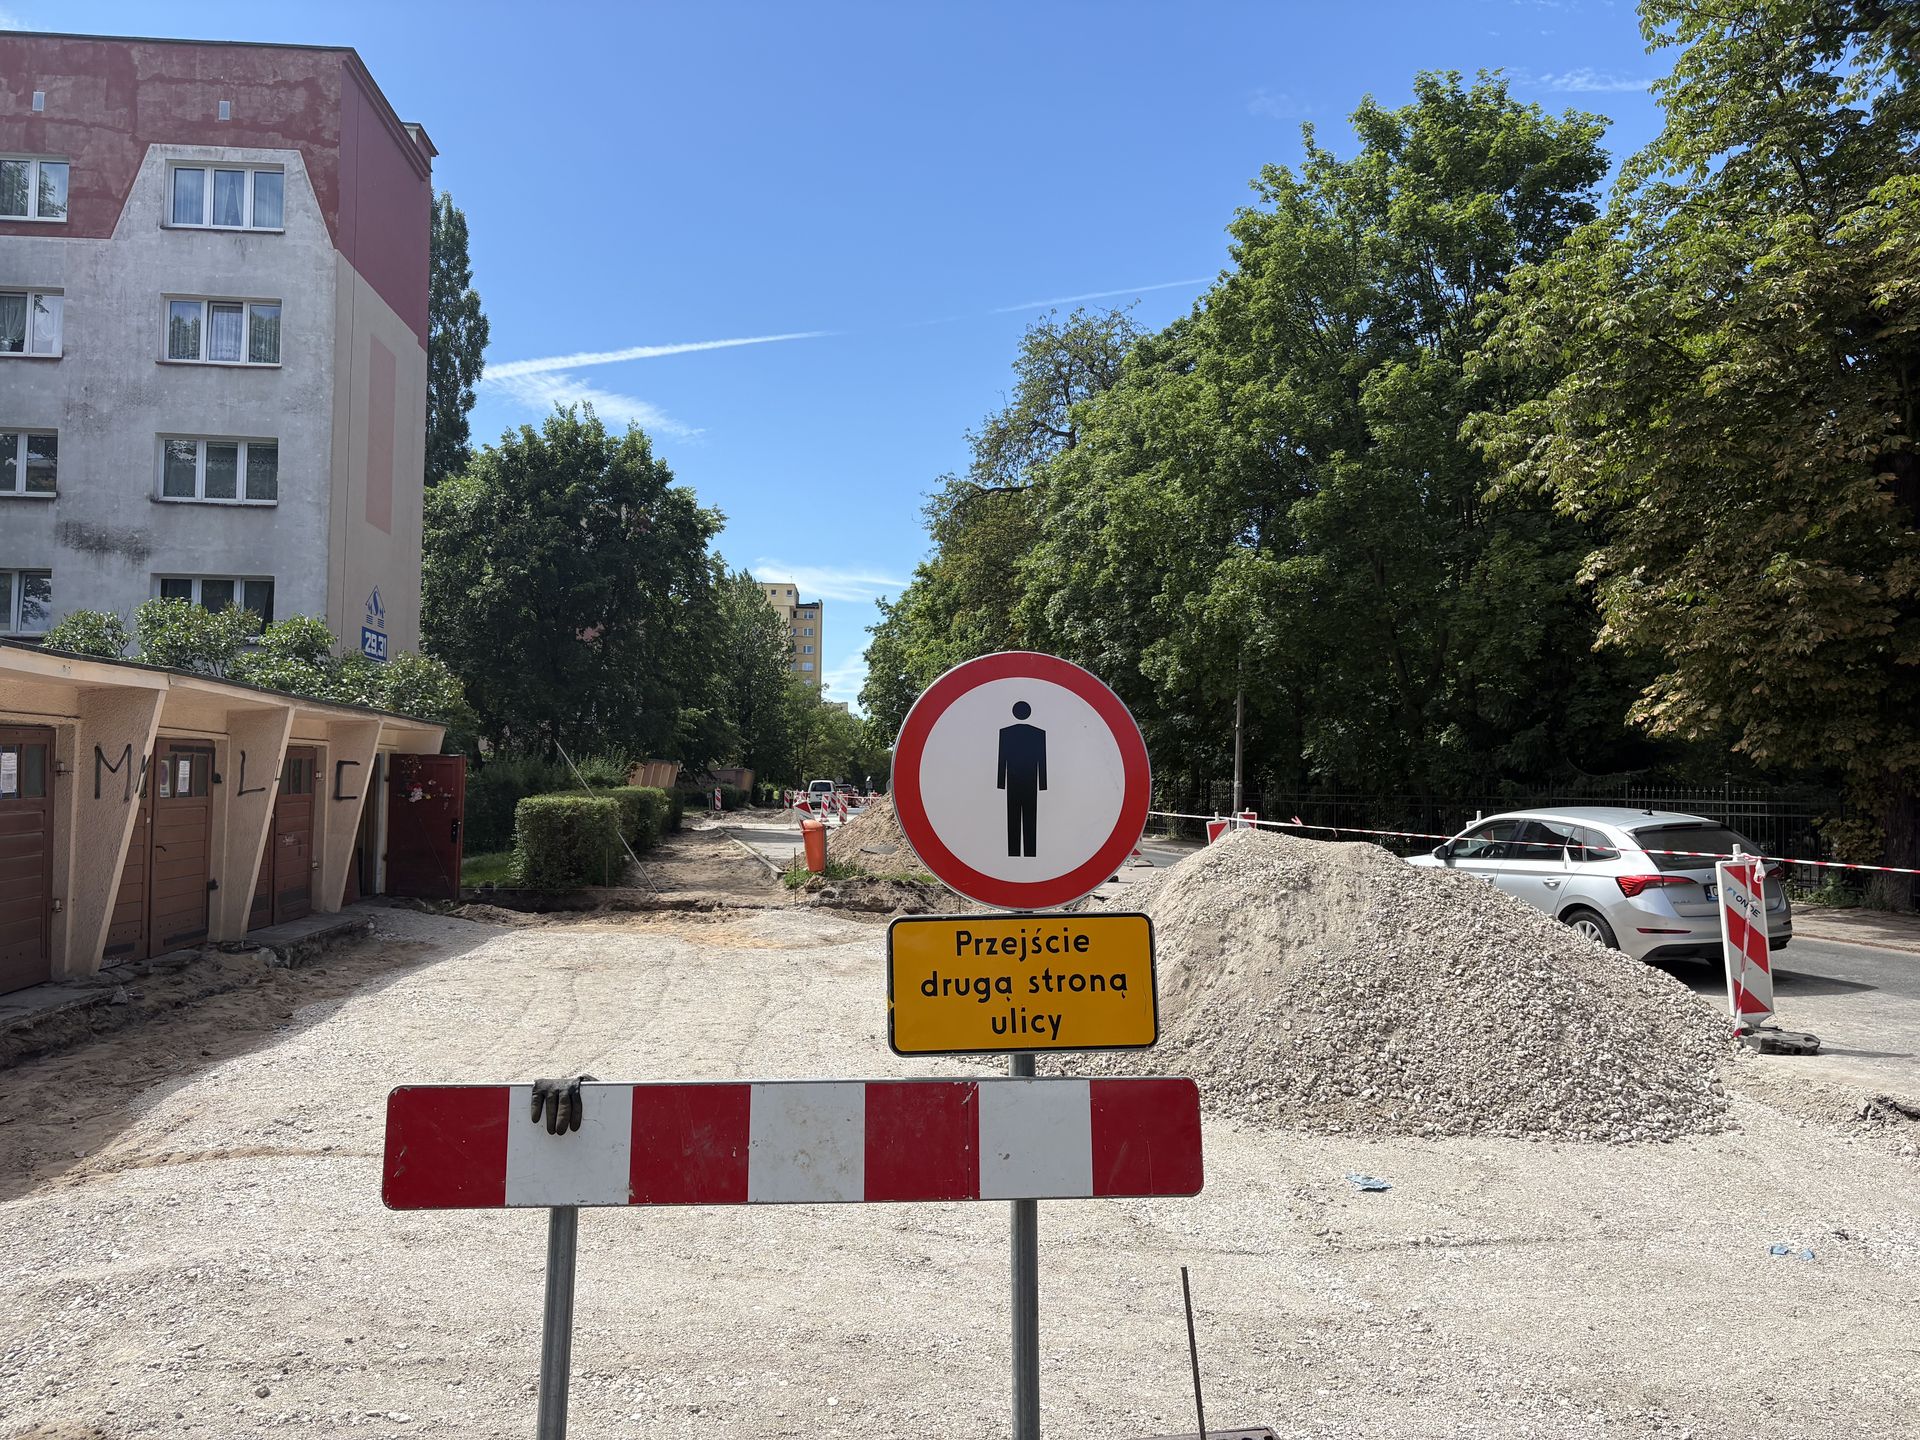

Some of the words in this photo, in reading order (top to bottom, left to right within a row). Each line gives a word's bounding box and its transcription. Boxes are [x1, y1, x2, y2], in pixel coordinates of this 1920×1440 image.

[956, 927, 1090, 962] Przejście
[920, 970, 1013, 1003] drugą
[1028, 967, 1128, 999] stroną
[991, 1007, 1062, 1041] ulicy
